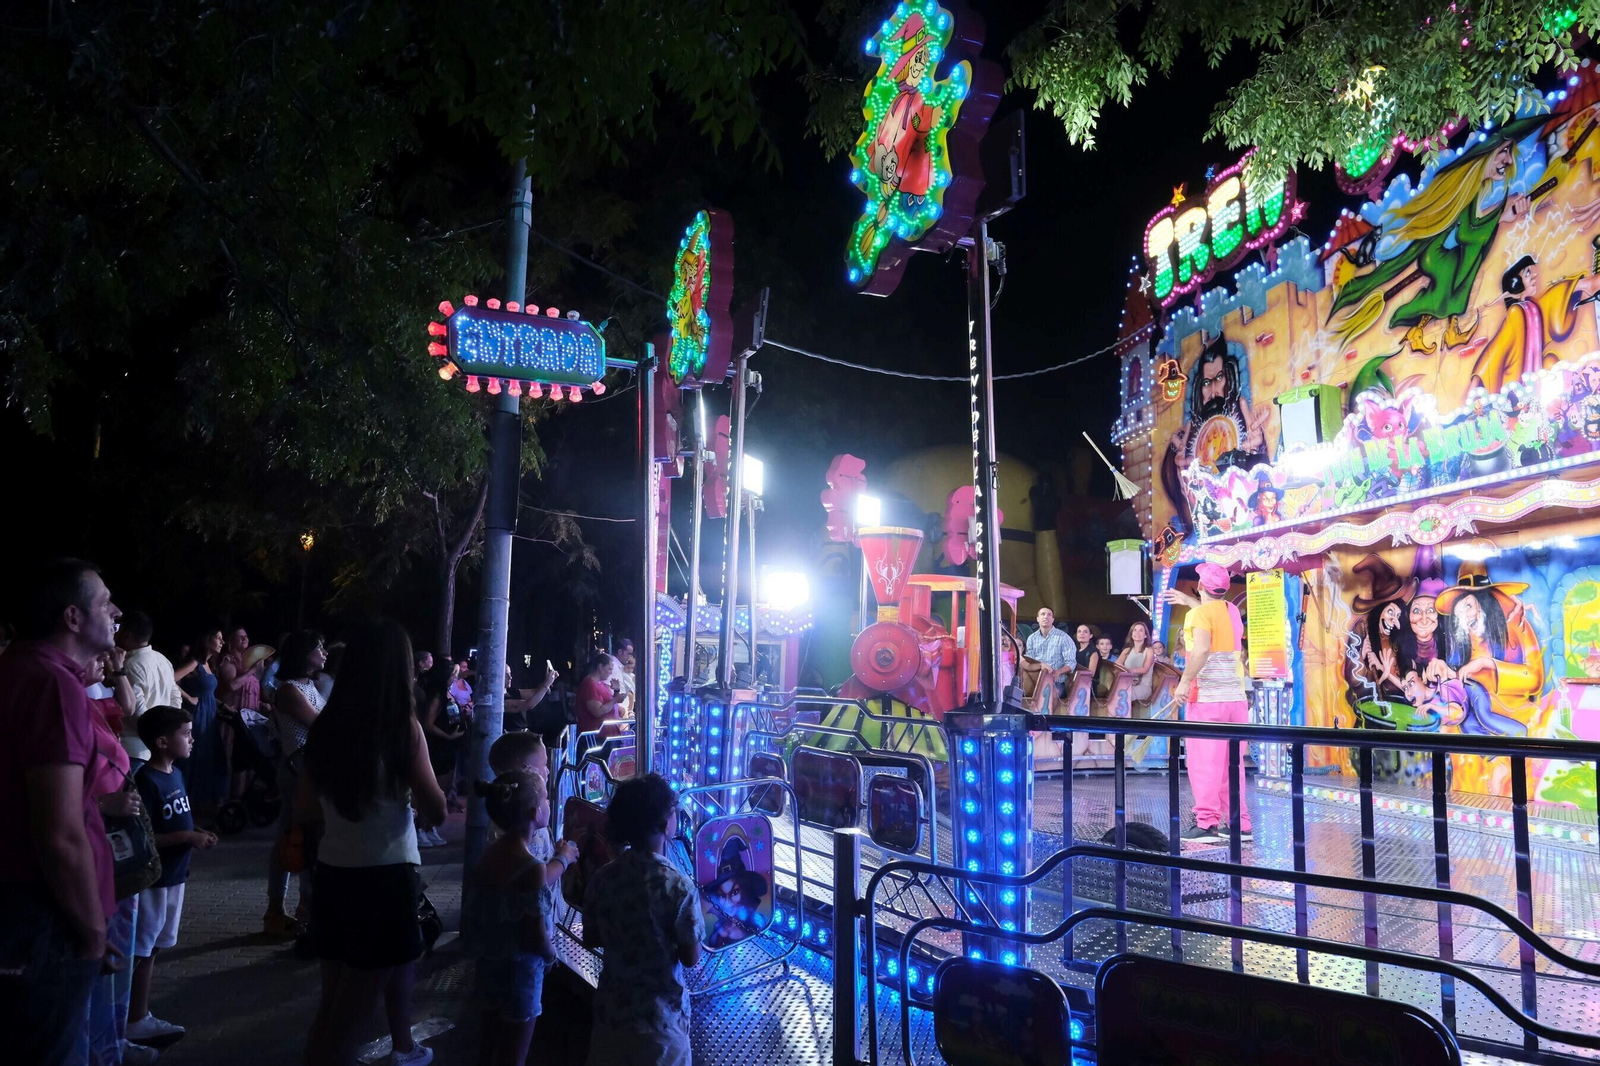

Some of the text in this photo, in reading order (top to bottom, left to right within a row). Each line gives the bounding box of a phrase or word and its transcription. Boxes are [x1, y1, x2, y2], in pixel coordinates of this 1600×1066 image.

[456, 315, 598, 376] ENTRADA
[1364, 439, 1393, 471] DE
[1394, 434, 1425, 469] LA
[1422, 410, 1508, 465] BRUJA
[1041, 684, 1050, 715] 1
[1074, 686, 1088, 716] 2
[1115, 688, 1129, 717] 3
